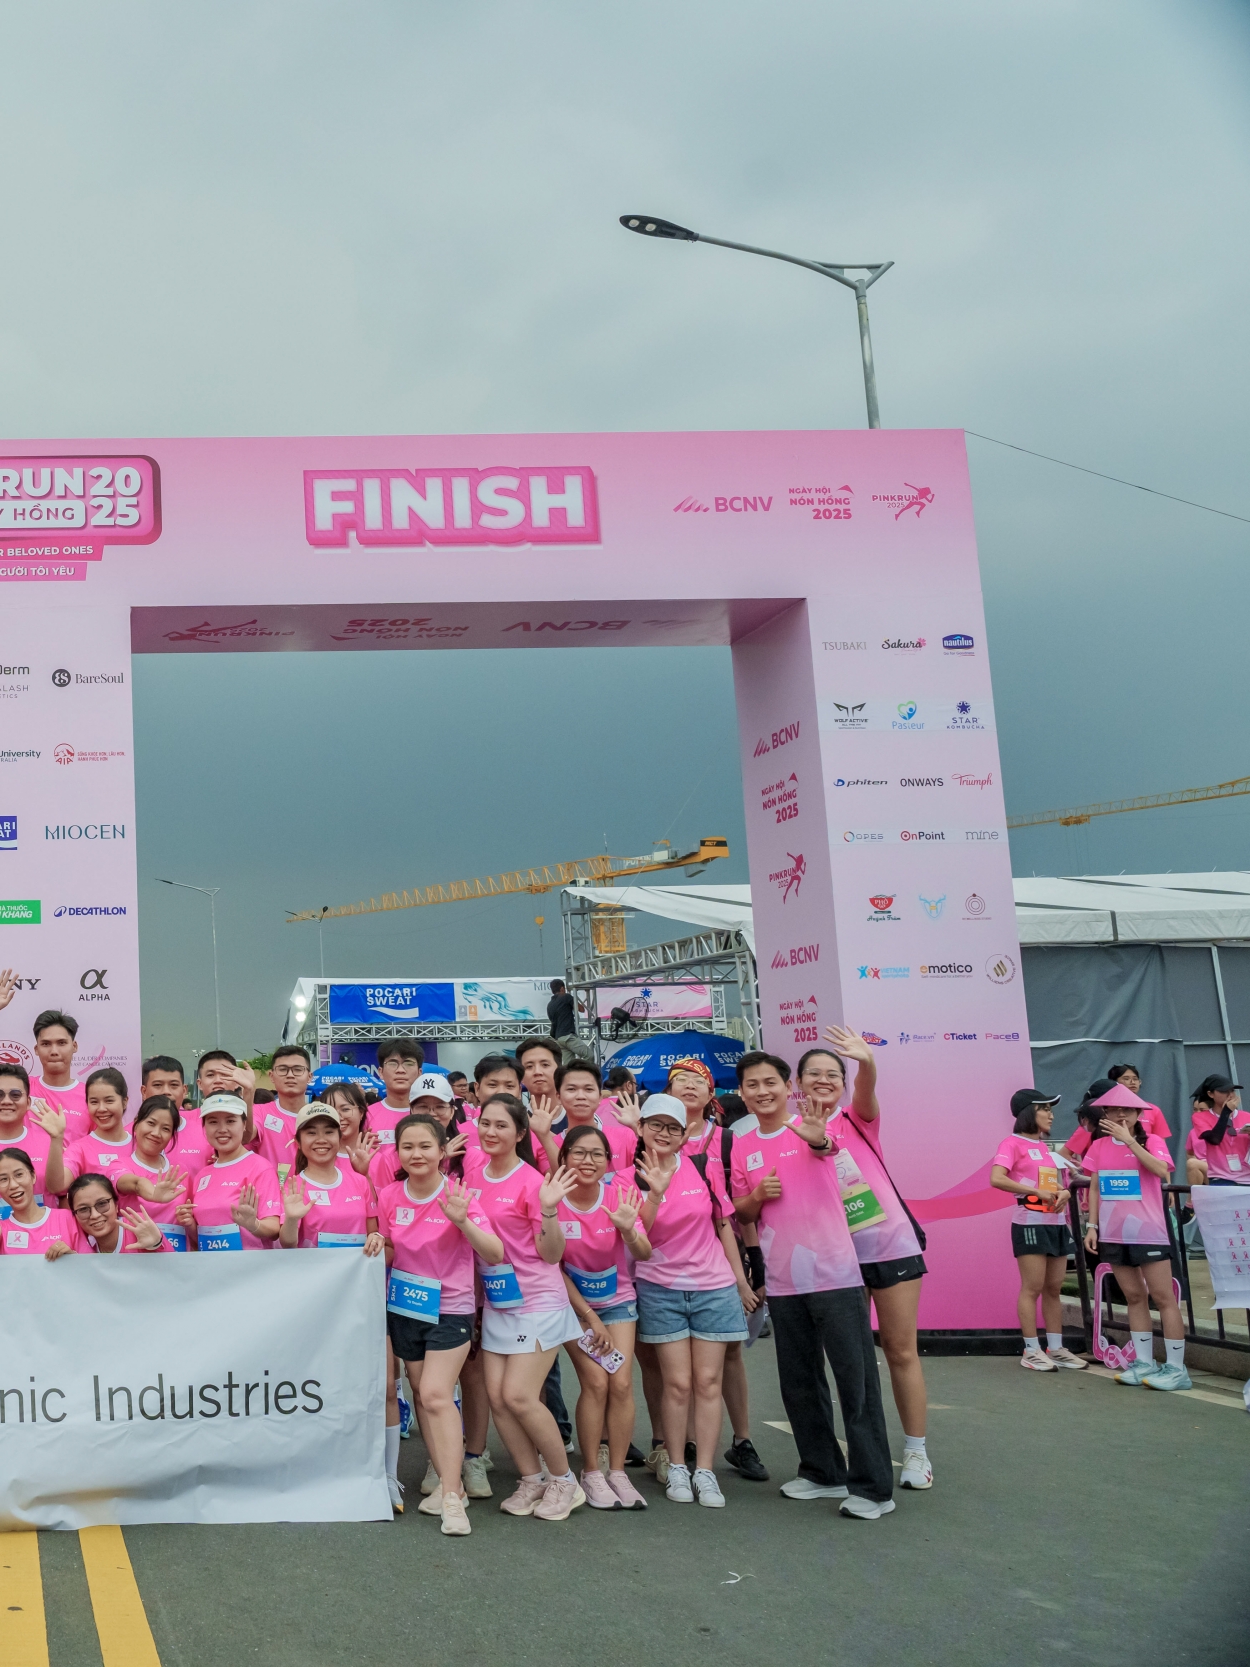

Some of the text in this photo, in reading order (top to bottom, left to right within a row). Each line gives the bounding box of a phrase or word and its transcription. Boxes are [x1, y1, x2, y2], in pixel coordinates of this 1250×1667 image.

[89, 467, 142, 496] 20
[788, 486, 831, 495] NGÀY HỘI
[313, 473, 588, 532] FINISH
[789, 495, 851, 506] NÓN HỒNG
[872, 494, 919, 502] PINKRUN
[714, 496, 773, 513] BCNV
[13, 503, 76, 522] HỒNG
[89, 497, 141, 526] 25
[811, 508, 852, 520] 2025
[7, 547, 60, 557] BELOVED
[62, 546, 94, 555] ONES
[30, 566, 49, 576] TÔI
[51, 565, 75, 576] YÊU
[347, 618, 433, 628] 2025
[502, 620, 632, 632] BCNV
[822, 641, 867, 650] TSUBAKI
[881, 638, 923, 650] Sakura
[943, 636, 973, 647] nautilus
[75, 673, 124, 684] BareSoul
[892, 721, 925, 729] Pasteur
[771, 721, 800, 749] BCNV
[847, 779, 888, 787] phiten
[900, 778, 944, 787] ONWAYS
[951, 773, 993, 790] Triumph
[775, 803, 799, 824] 2025
[45, 824, 125, 840] MIOCEN
[900, 830, 945, 841] OnPoint
[965, 830, 999, 840] mine
[769, 866, 797, 882] PINKRUN
[3, 911, 33, 919] KHANG
[68, 906, 127, 916] DECATHLON
[790, 944, 820, 966] BCNV
[920, 962, 973, 974] emotico
[78, 993, 111, 1001] ALPHA
[366, 988, 417, 997] POCARI
[366, 996, 412, 1006] SWEAT
[794, 1026, 818, 1043] 2025
[943, 1032, 977, 1041] CTicket
[659, 1053, 705, 1061] POCARI
[1109, 1179, 1129, 1187] 1959
[207, 1238, 230, 1249] 2414
[484, 1279, 506, 1290] 2407
[581, 1280, 607, 1289] 2418
[403, 1286, 429, 1302] 2475
[93, 1369, 324, 1422] Industries
